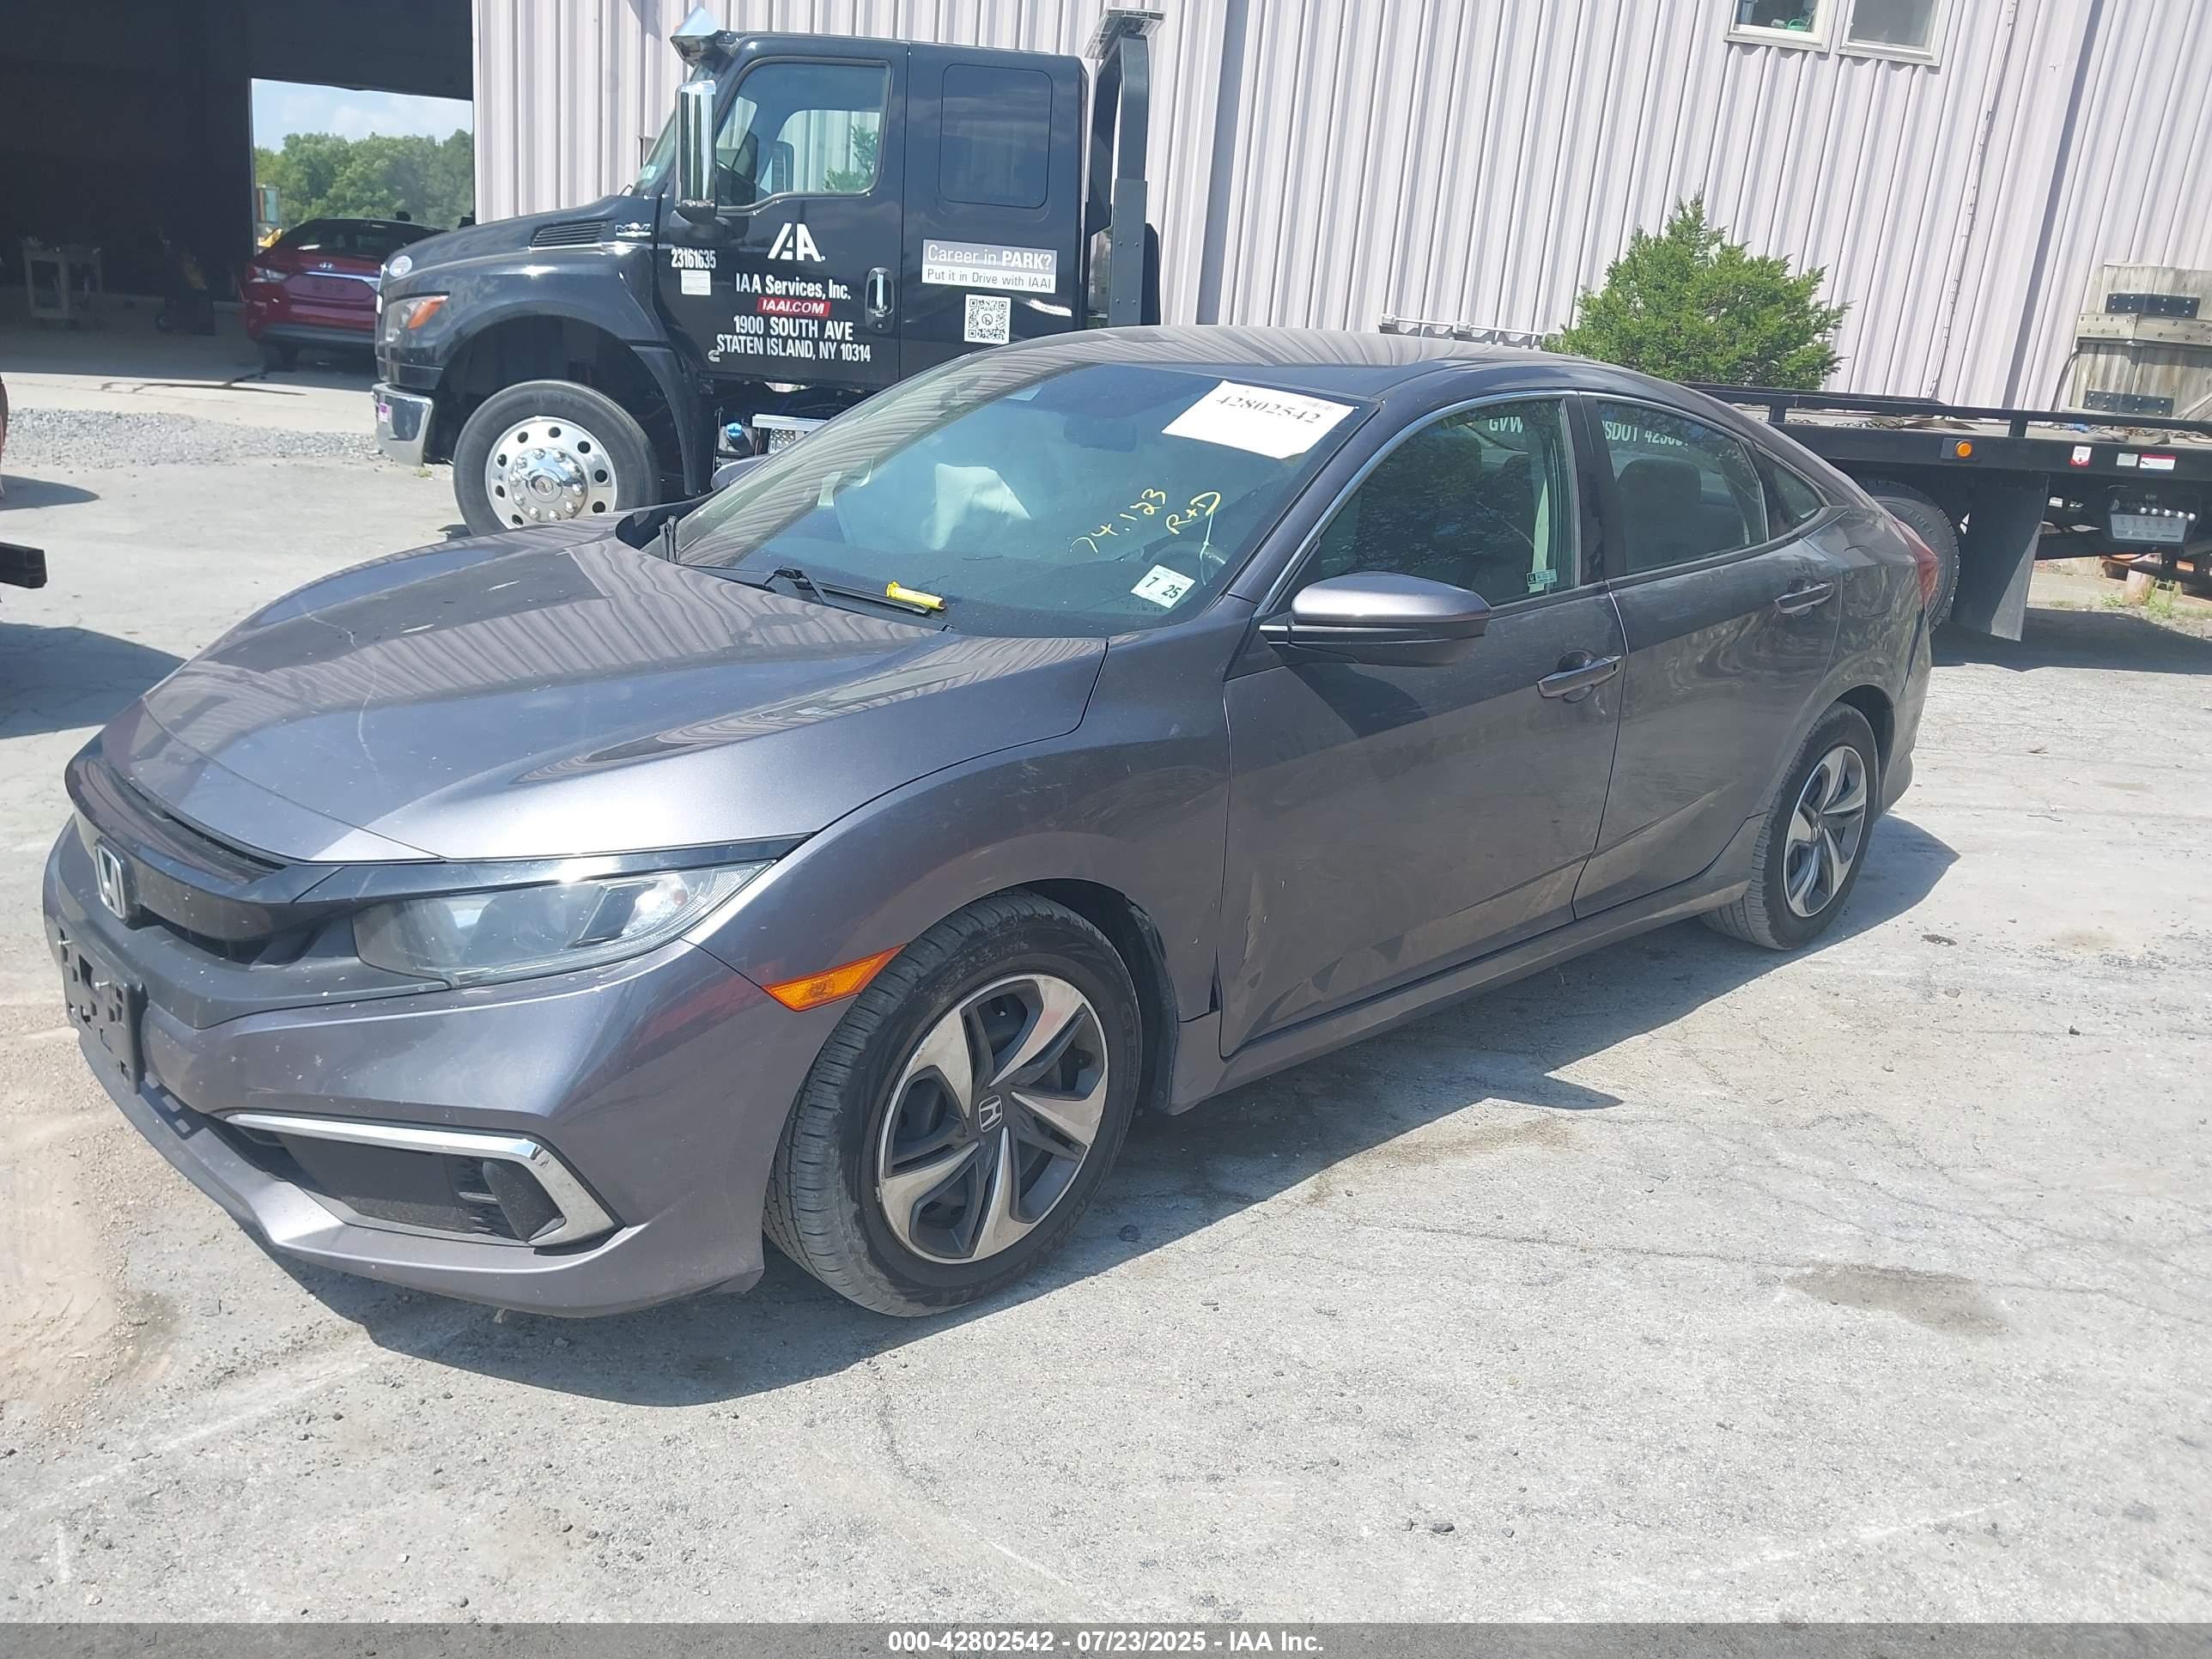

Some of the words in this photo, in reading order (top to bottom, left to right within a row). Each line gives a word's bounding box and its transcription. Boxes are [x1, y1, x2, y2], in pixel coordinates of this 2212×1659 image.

[671, 247, 716, 269] 23161635
[927, 244, 980, 264] Career
[984, 249, 997, 265] in
[1001, 250, 1052, 270] PARK?
[736, 272, 762, 294] IAA
[765, 275, 826, 300] Services,
[829, 279, 852, 300] Inc.
[927, 268, 945, 280] Put
[948, 270, 956, 281] it
[958, 271, 968, 282] in
[971, 272, 998, 284] Drive
[1001, 275, 1024, 287] with
[1028, 277, 1052, 289] IAAI
[762, 299, 825, 314] IAAI.COM
[733, 315, 764, 335] 1900
[769, 318, 818, 337] SOUTH
[824, 321, 854, 341] AVE
[716, 333, 764, 356] STATEN
[766, 339, 817, 362] ISLAND,
[818, 342, 836, 360] NY
[840, 344, 872, 362] 10314
[1215, 394, 1322, 424] 42802542
[1144, 576, 1159, 589] 7
[1161, 583, 1182, 600] 25
